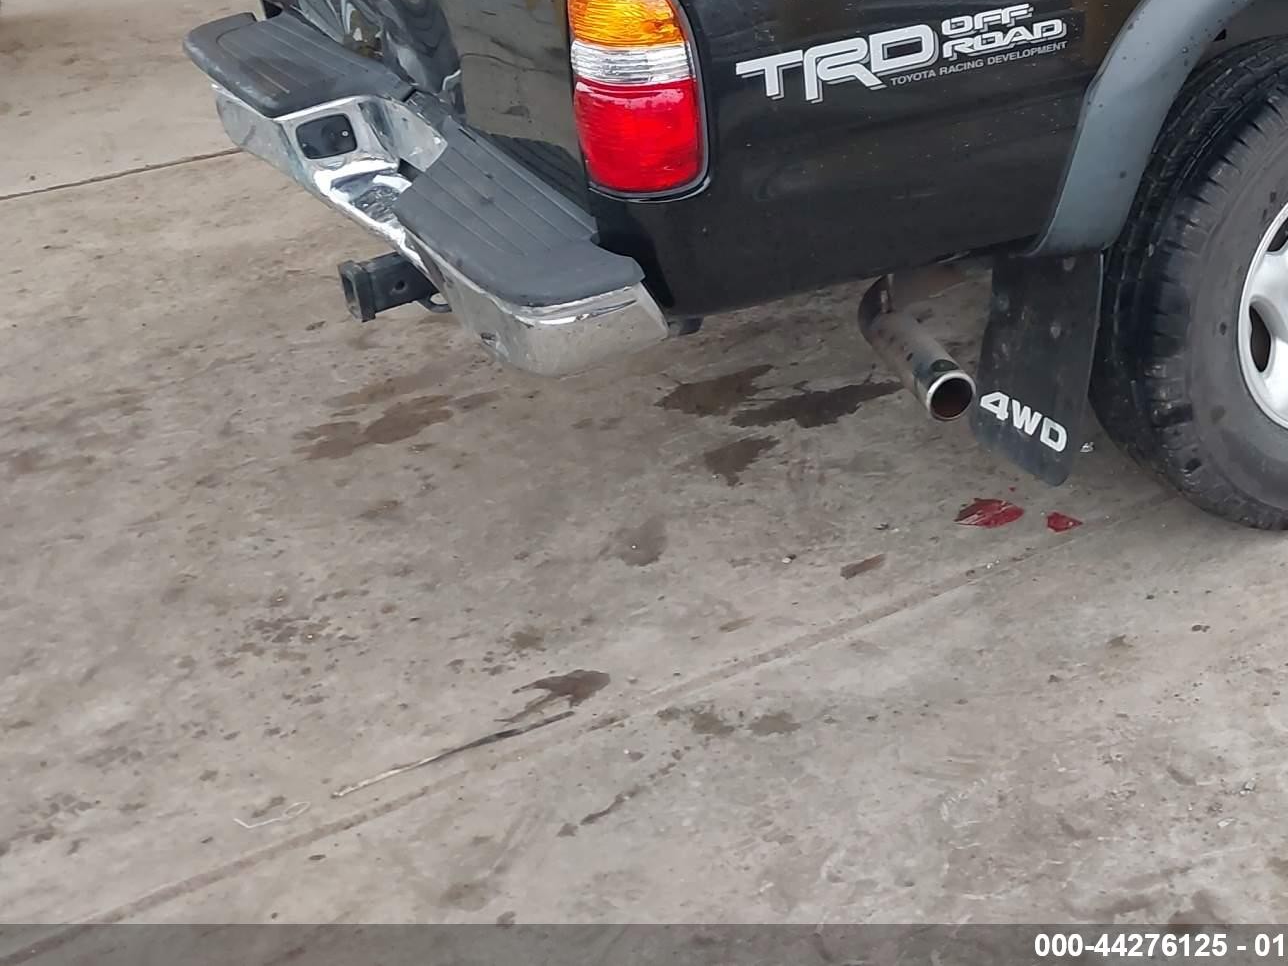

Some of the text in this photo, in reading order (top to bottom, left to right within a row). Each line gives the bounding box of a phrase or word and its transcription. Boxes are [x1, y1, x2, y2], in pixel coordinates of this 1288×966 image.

[941, 3, 1034, 38] OFF
[942, 18, 1067, 61] ROAD
[736, 24, 939, 104] TRD
[890, 41, 1068, 86] TOYOTA RACING DEVELOPMENT
[979, 391, 1067, 452] 4WD
